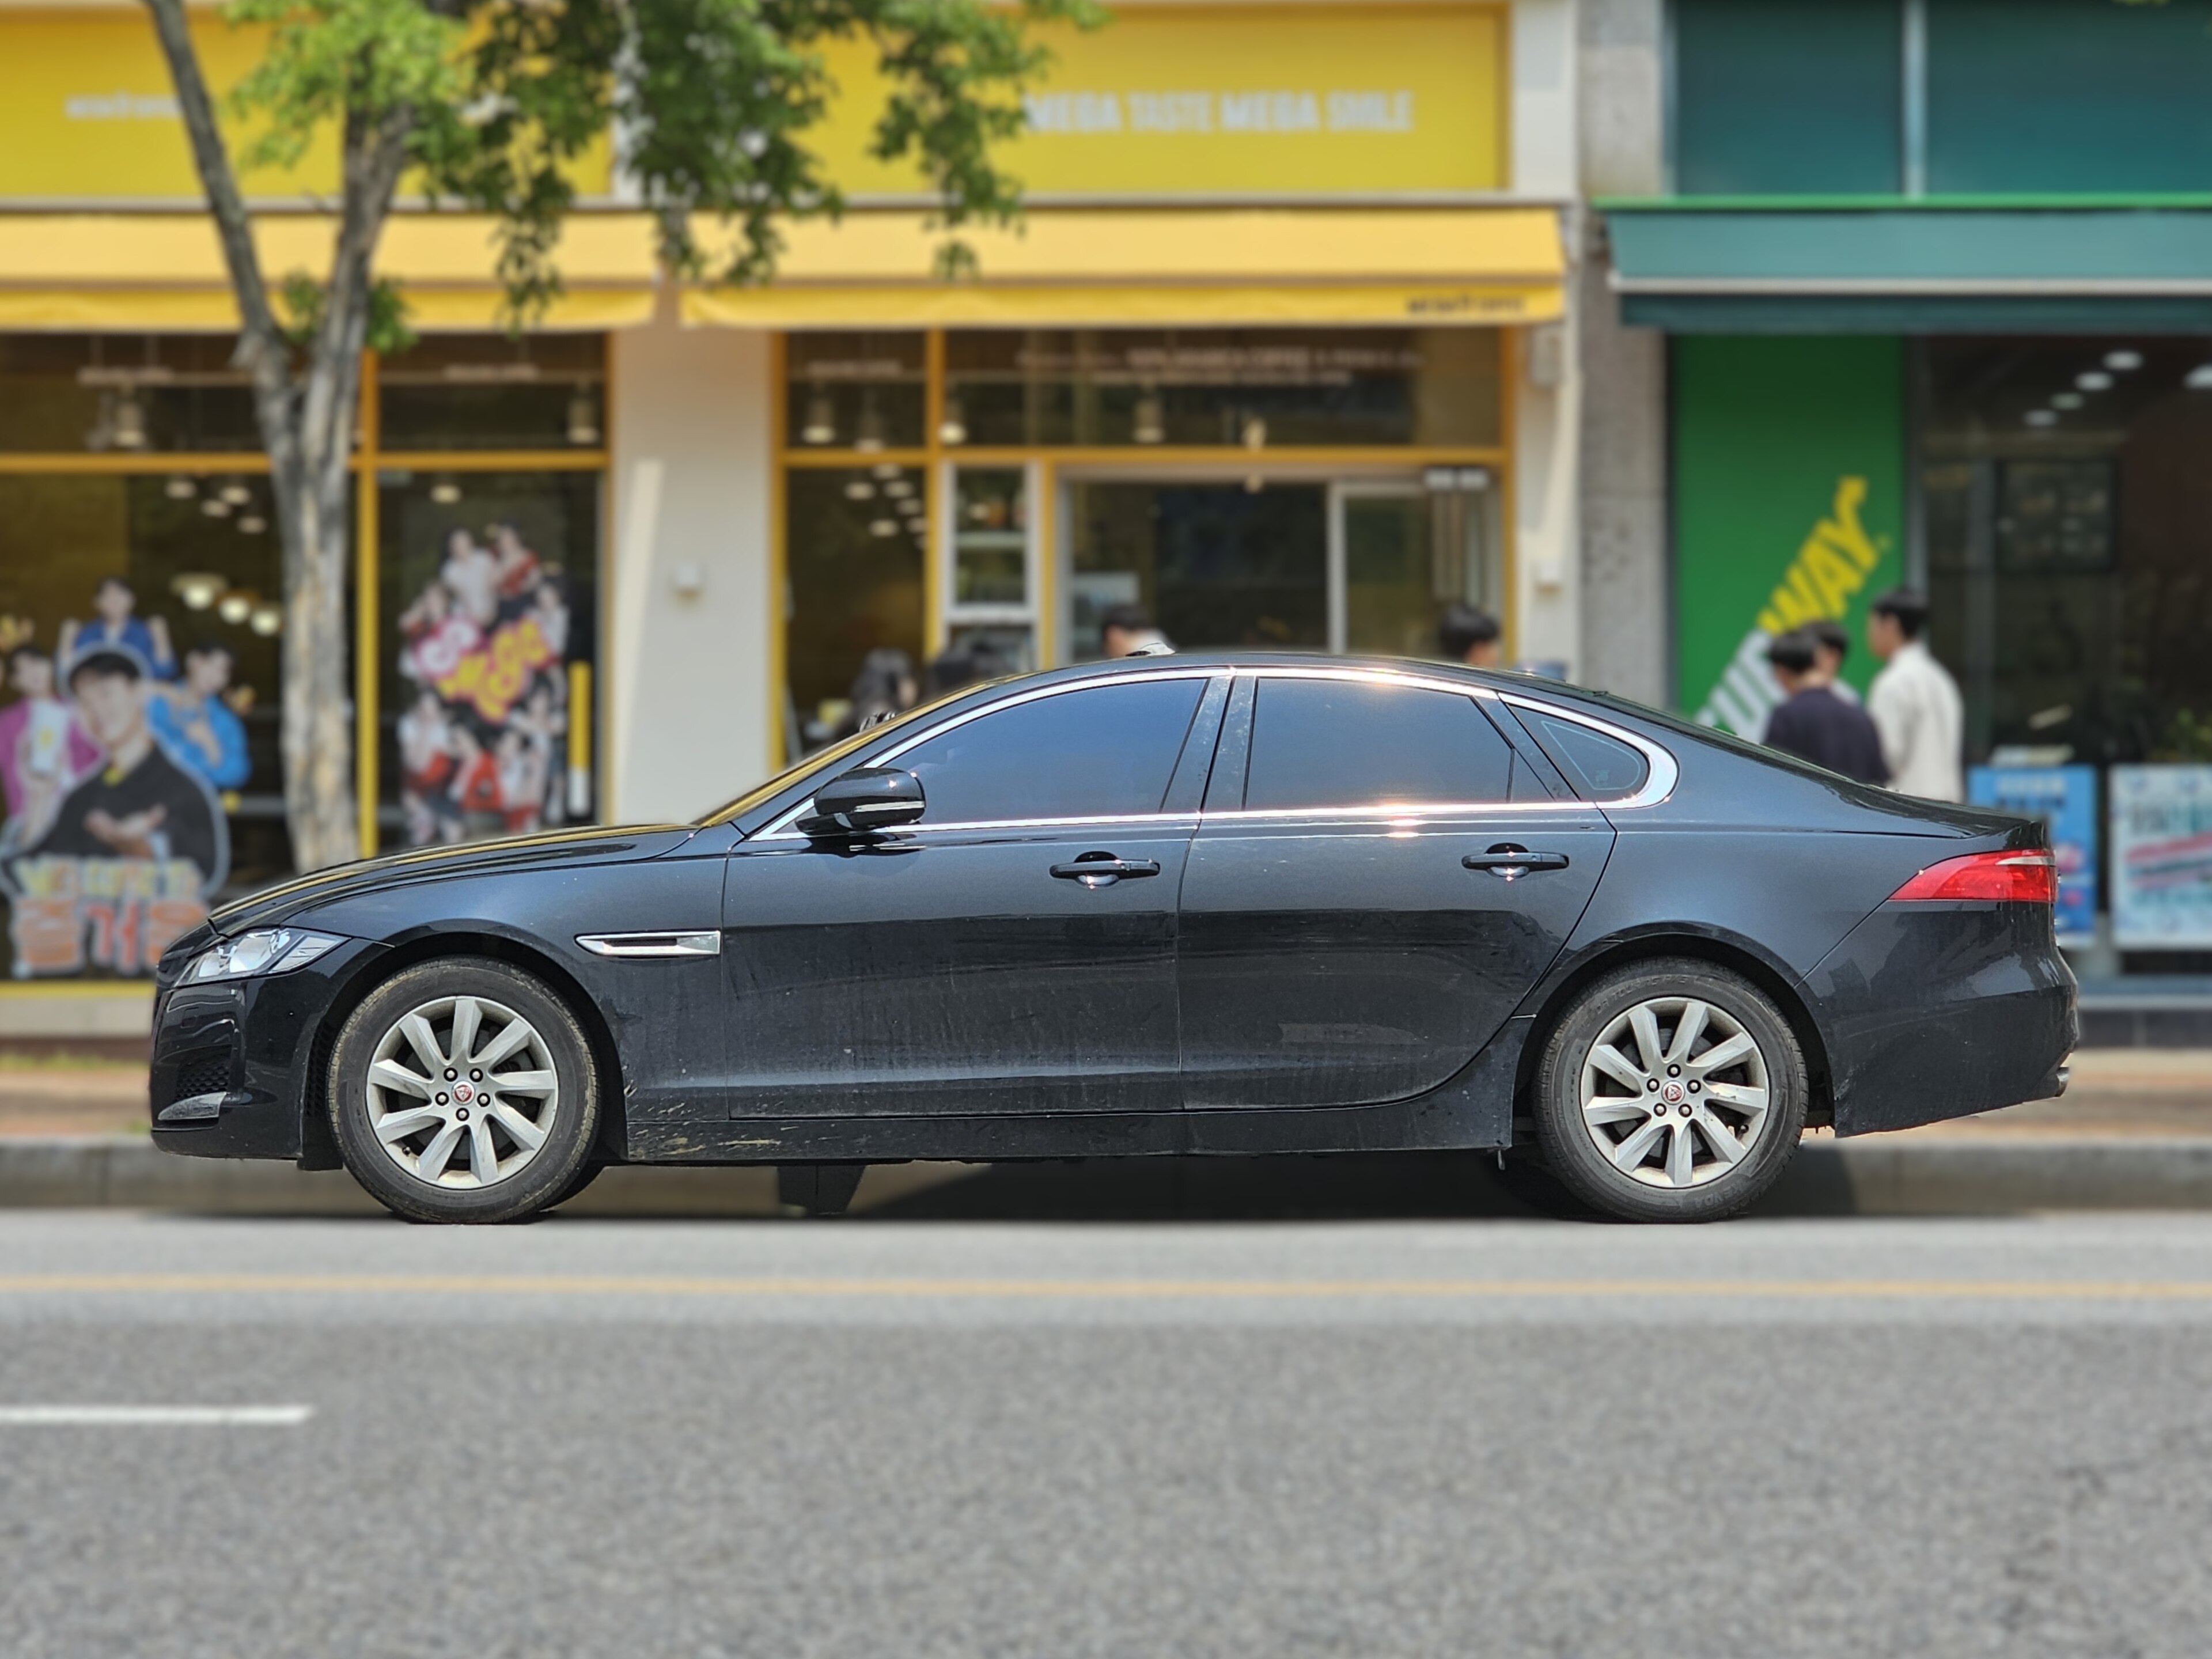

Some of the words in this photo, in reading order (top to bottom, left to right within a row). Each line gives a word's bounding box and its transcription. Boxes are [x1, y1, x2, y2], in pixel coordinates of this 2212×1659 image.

[1220, 90, 1320, 132] MEGA
[1694, 474, 1877, 744] UWAY
[1694, 1181, 1744, 1209] KENDA
